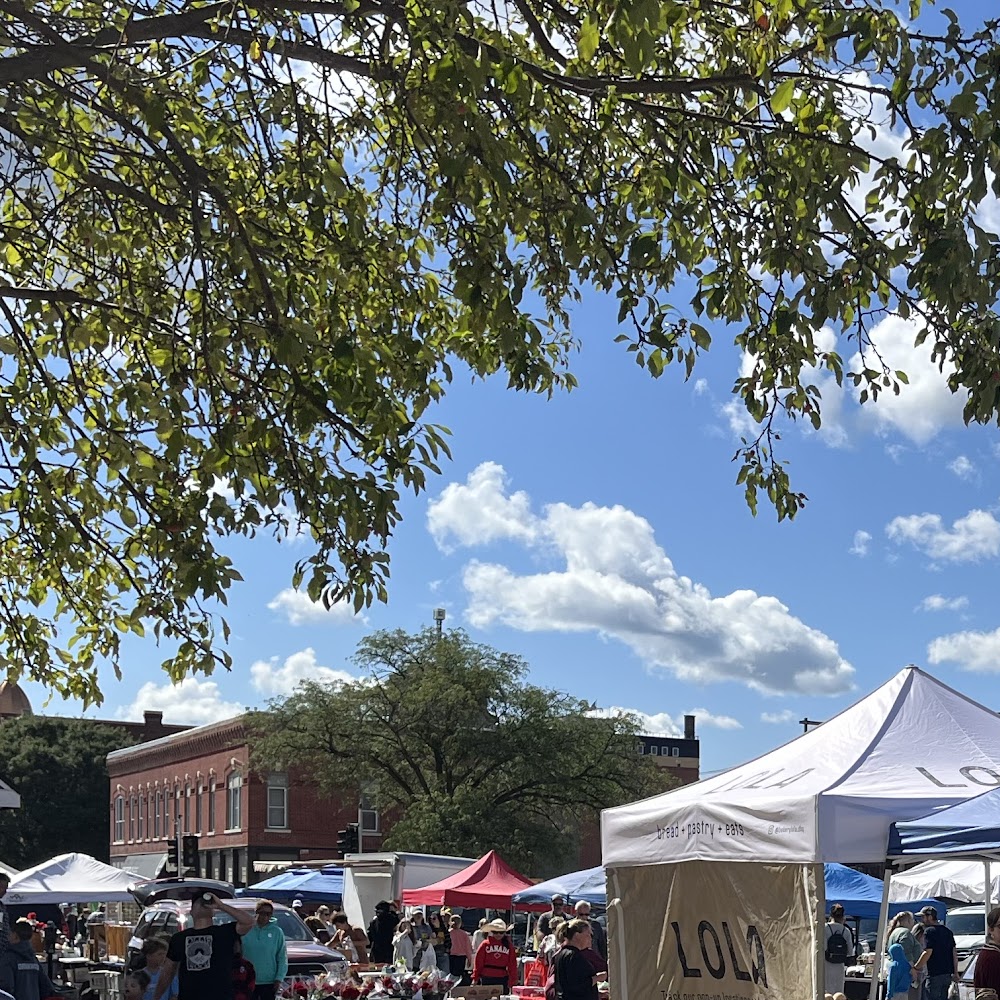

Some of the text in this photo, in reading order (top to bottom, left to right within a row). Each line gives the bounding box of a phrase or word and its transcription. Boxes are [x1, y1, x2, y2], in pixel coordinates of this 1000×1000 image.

[702, 767, 816, 795] LOLA
[656, 822, 679, 839] bread
[687, 821, 715, 839] pastry
[725, 821, 745, 836] eats
[485, 944, 511, 955] CANADA
[670, 920, 769, 989] LOLA
